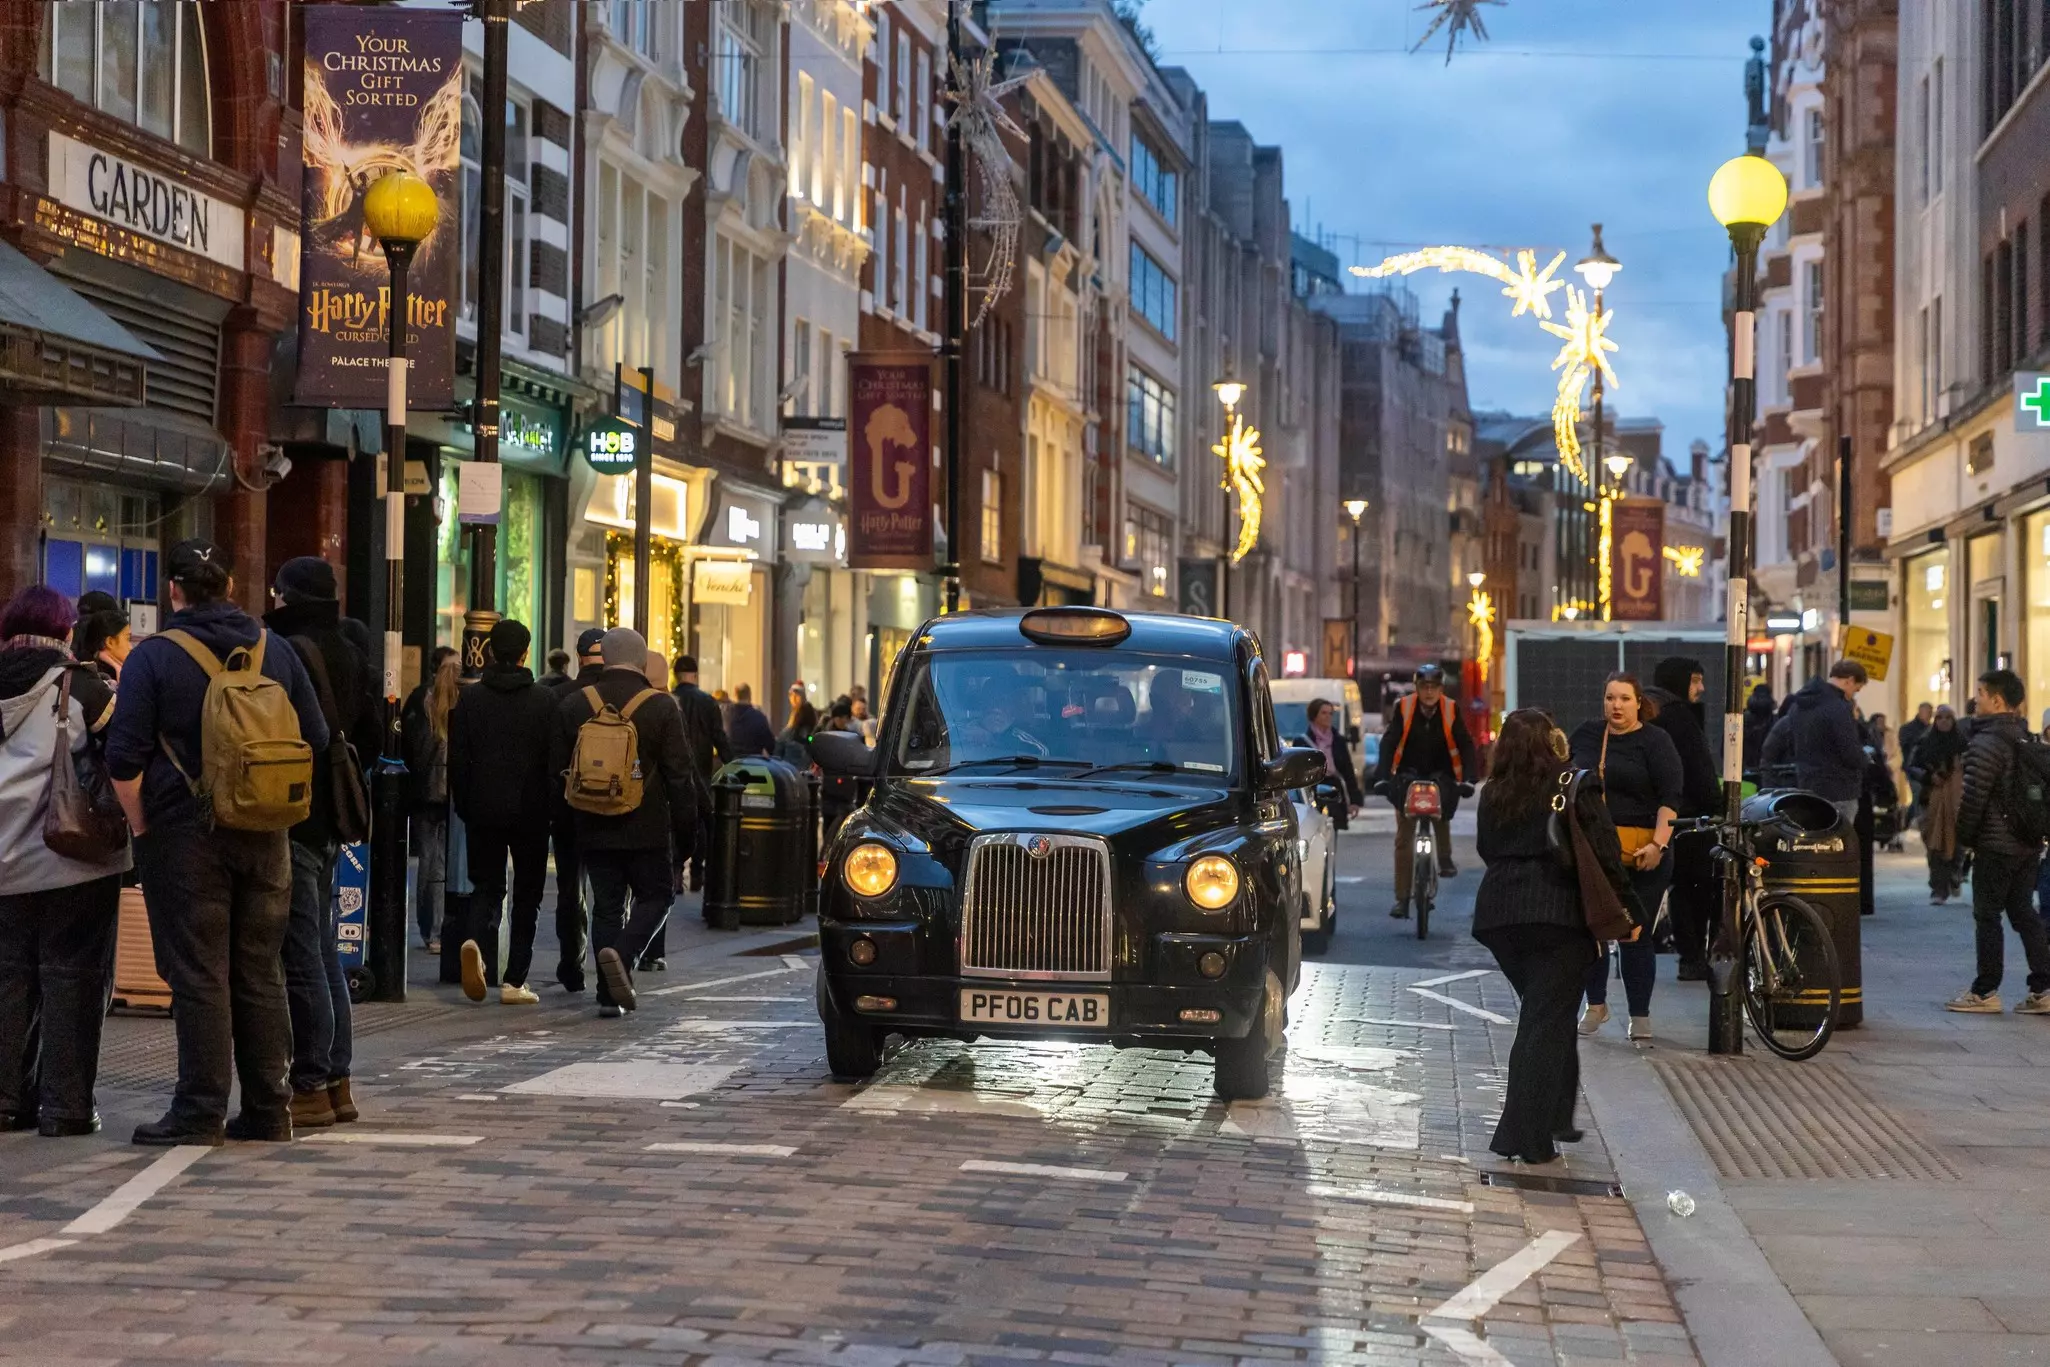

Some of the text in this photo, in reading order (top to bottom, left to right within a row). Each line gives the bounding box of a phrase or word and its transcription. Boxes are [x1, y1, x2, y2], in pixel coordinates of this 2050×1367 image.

[355, 35, 411, 53] YOUR
[323, 52, 441, 72] CHRISTMAS
[361, 73, 404, 89] GIFT
[346, 89, 418, 106] SORTED
[88, 153, 209, 252] GARDEN
[306, 286, 447, 338] Harry Ptter
[335, 331, 419, 344] CURSED CLD
[331, 356, 416, 369] PALACE THERE
[972, 993, 1098, 1022] PF06 CAB
